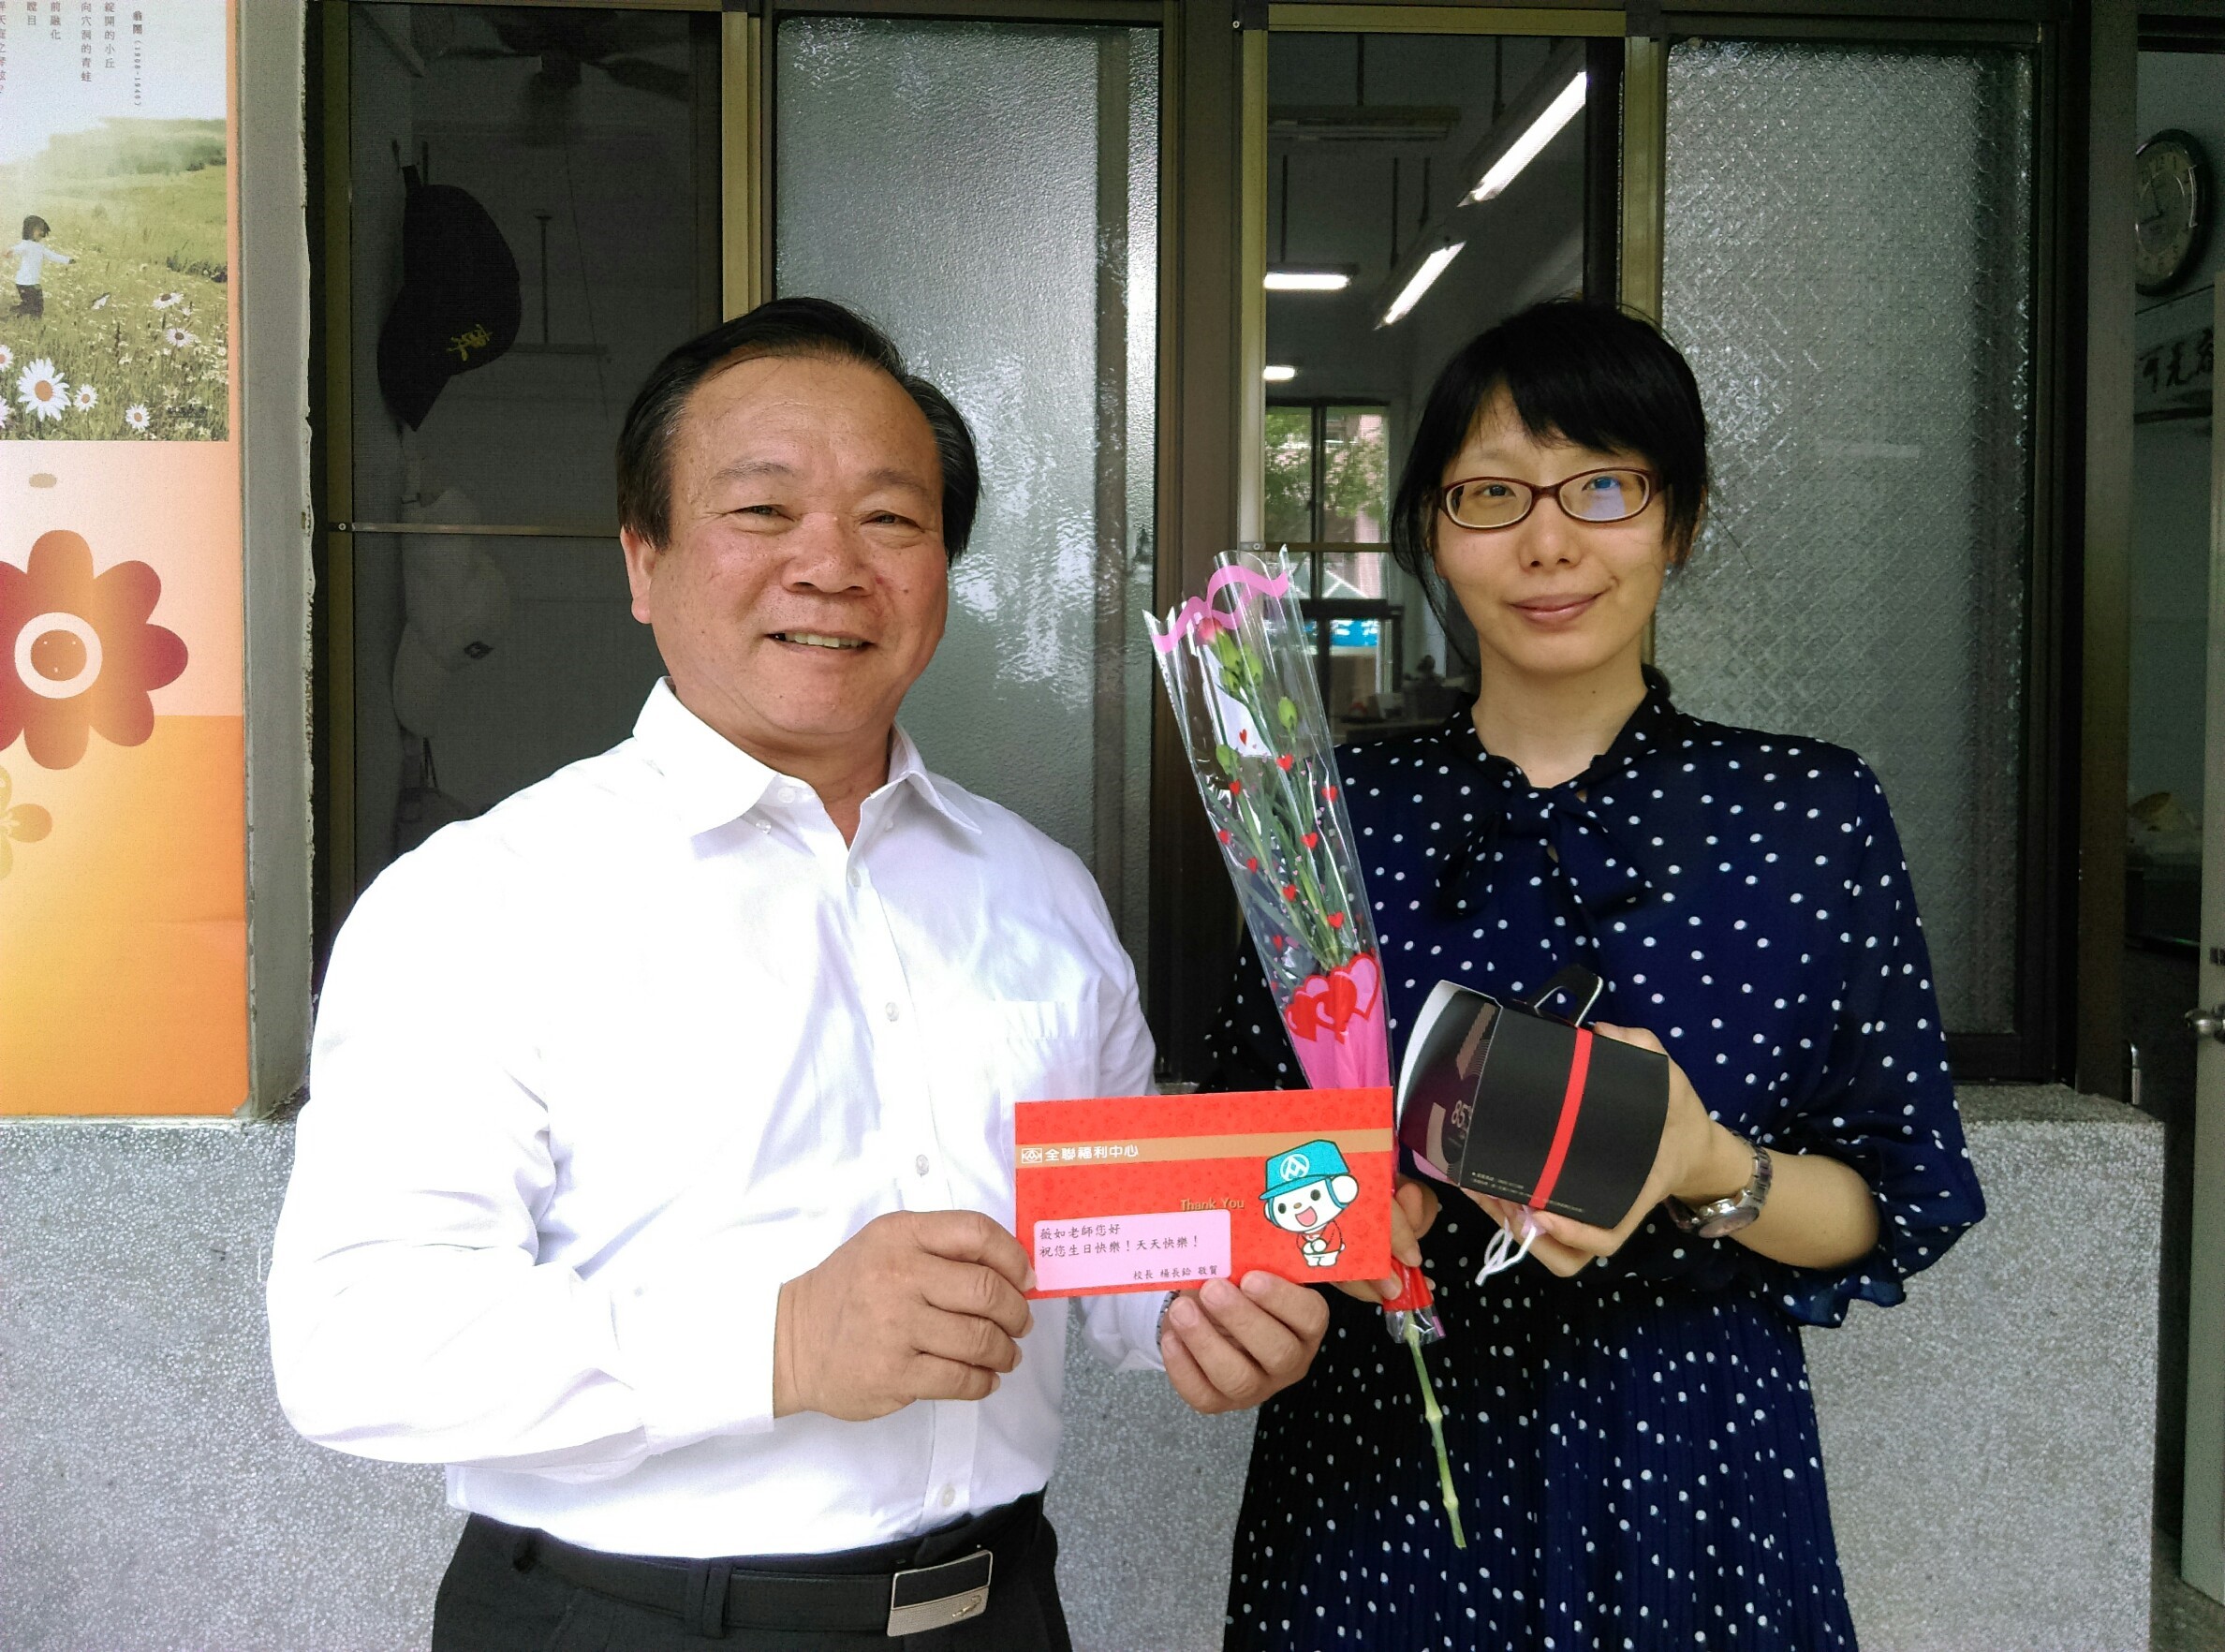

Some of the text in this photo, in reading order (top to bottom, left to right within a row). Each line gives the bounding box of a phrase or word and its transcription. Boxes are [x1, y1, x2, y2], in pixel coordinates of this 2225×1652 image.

[1044, 1143, 1139, 1162] 全聯福利中心
[1180, 1197, 1245, 1212] Thank You
[1039, 1223, 1121, 1240] 薇如老師您好
[1133, 1269, 1154, 1280] 校長
